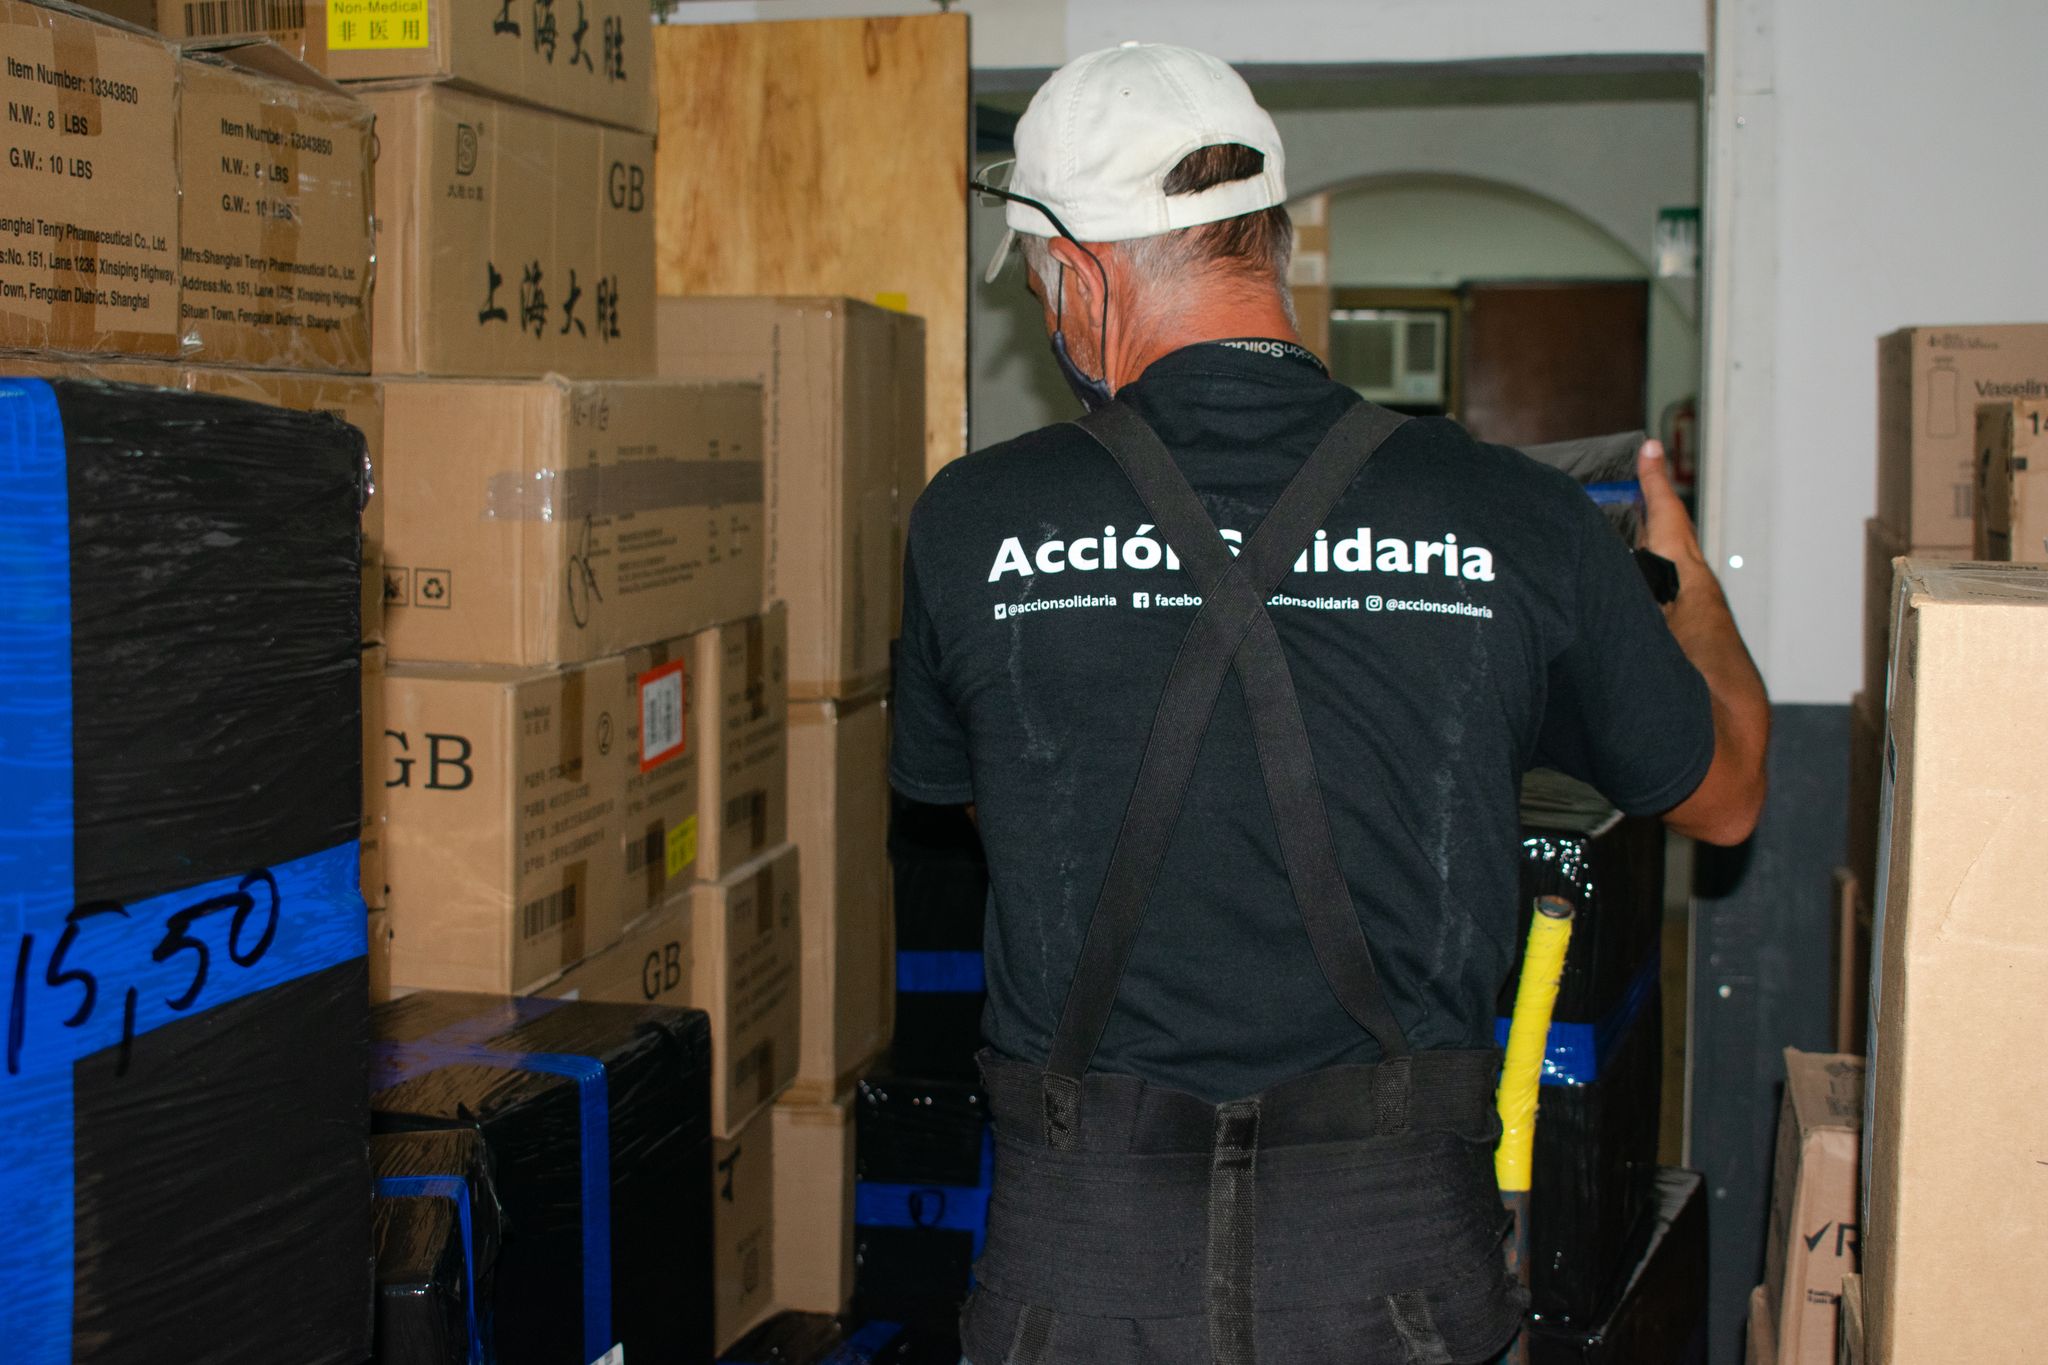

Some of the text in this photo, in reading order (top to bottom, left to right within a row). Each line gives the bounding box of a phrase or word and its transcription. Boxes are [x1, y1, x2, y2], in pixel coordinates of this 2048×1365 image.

[339, 19, 420, 41] 非医用
[8, 57, 138, 105] Item Number: 13343850
[9, 102, 88, 135] N.W.: 8 LBS
[221, 118, 244, 139] Item
[10, 147, 93, 180] G.W.: 10 LBS
[222, 157, 249, 177] N.W.:
[269, 165, 289, 183] LBS
[609, 161, 644, 213] GB
[222, 194, 250, 213] G.W.:
[256, 199, 267, 217] 10
[37, 220, 64, 242] Tenry
[66, 223, 133, 247] Pharmaceutical
[49, 252, 72, 271] Lane
[99, 258, 139, 282] Xinsiping
[29, 282, 72, 304] Fengxian
[110, 290, 150, 312] Shanghai
[1008, 595, 1117, 617] @accionsolidaria
[1385, 598, 1493, 619] @accionsolidaria
[643, 941, 681, 1000] GB
